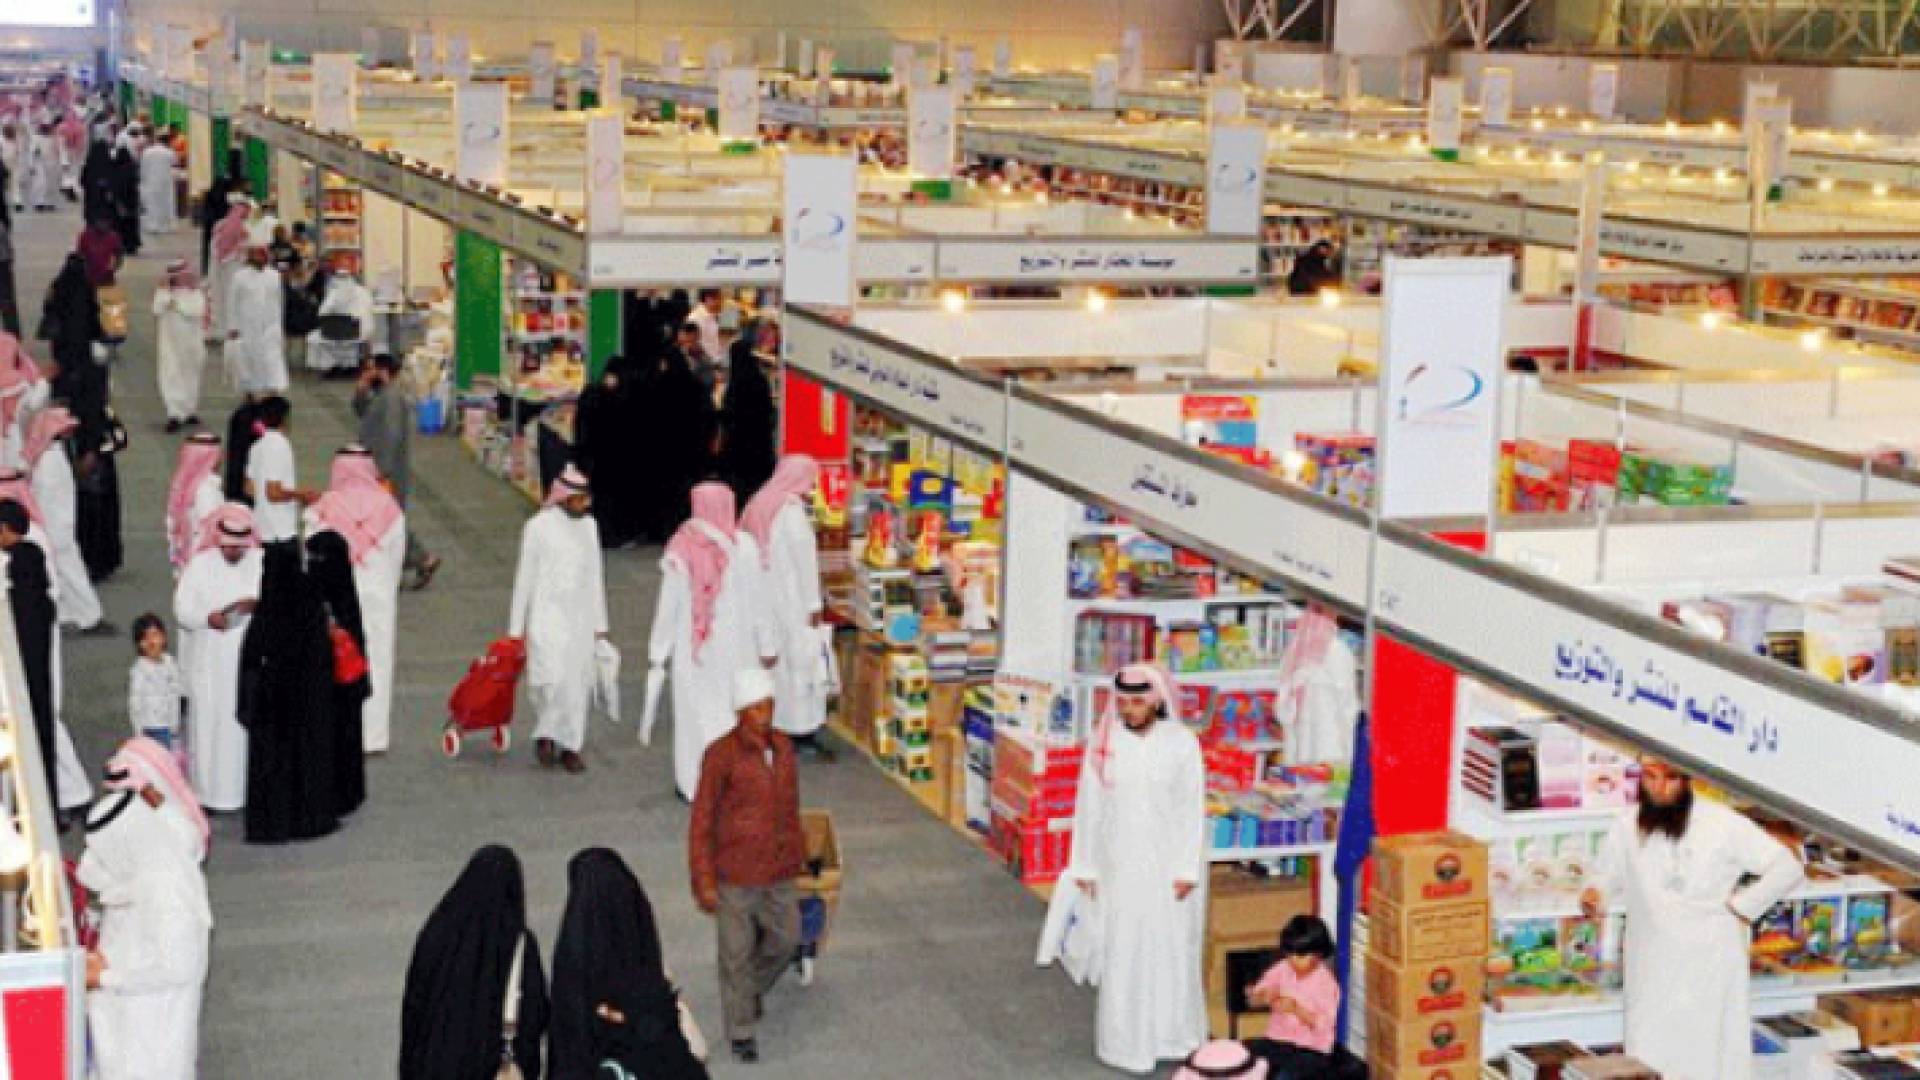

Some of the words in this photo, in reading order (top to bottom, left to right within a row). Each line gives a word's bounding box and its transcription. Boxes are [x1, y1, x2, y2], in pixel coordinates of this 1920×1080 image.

[1554, 637, 1625, 697] والتوزيع
[1626, 657, 1678, 710] للنشر
[1682, 694, 1745, 737] القاسم
[1746, 715, 1779, 754] دار
